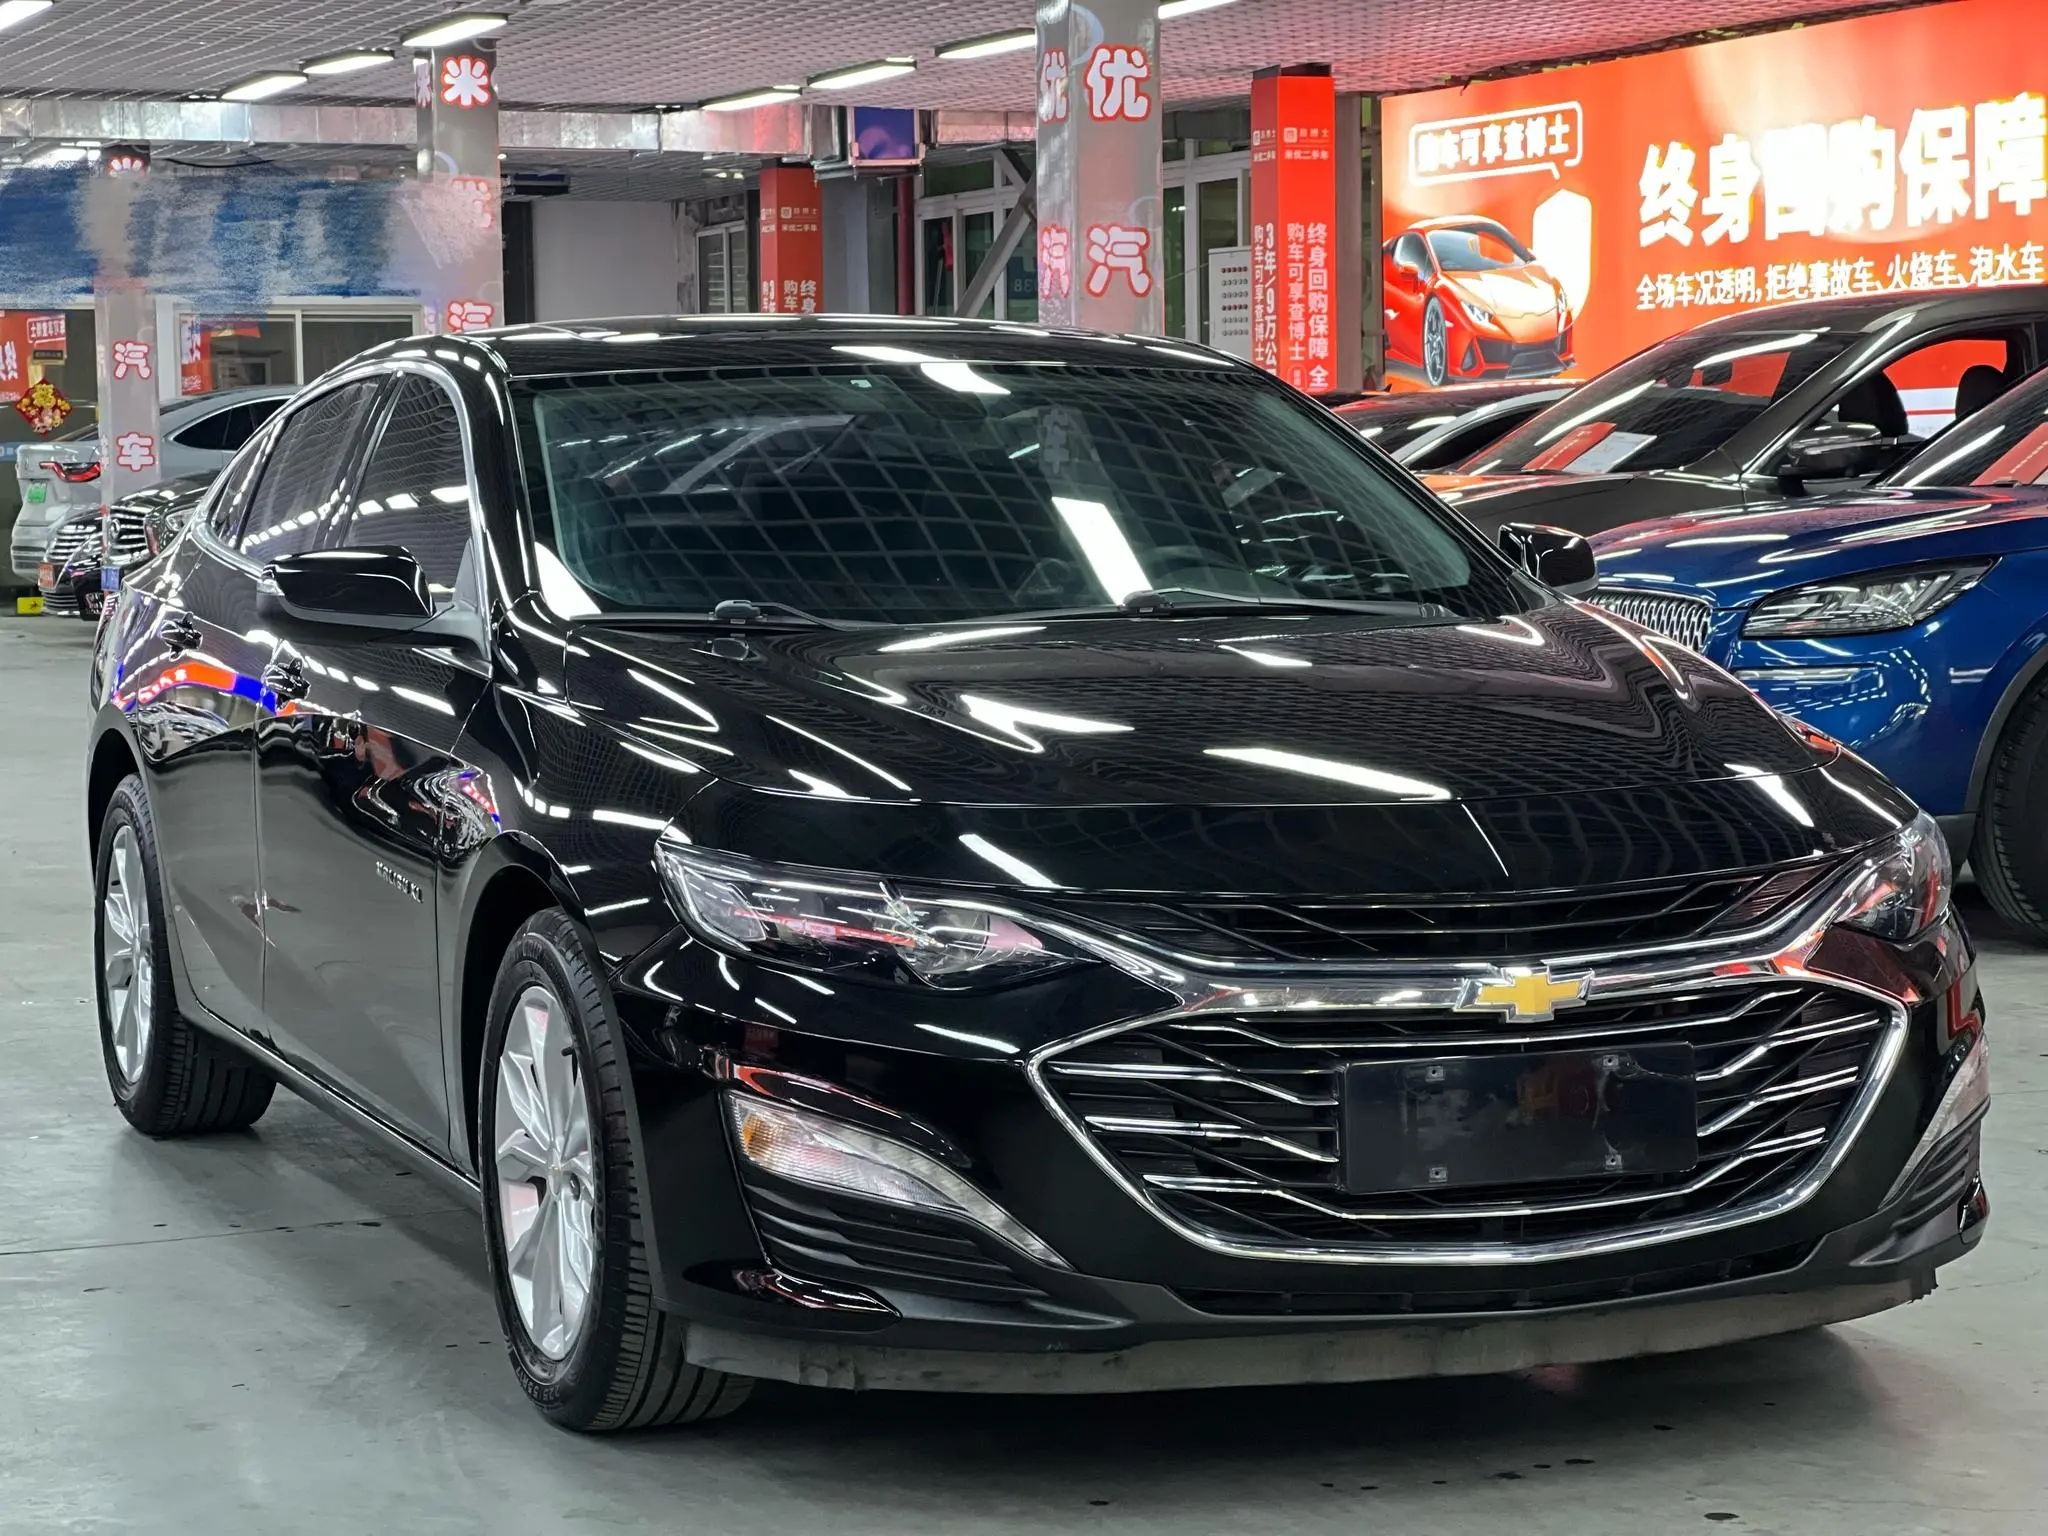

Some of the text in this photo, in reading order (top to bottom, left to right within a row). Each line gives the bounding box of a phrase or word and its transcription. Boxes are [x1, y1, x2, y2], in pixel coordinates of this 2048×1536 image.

[441, 56, 490, 108] 米
[1418, 113, 1570, 173] 车可享查博士
[1040, 48, 1070, 301] 优 汽
[1084, 45, 1152, 297] 优 汽
[1638, 92, 2047, 248] 终身回购保障
[1264, 222, 1276, 376] 3年/9万公
[1287, 222, 1305, 361] 购车可享查博士
[1307, 222, 1329, 388] 终身回购保障 全
[113, 340, 154, 472] 汽 车
